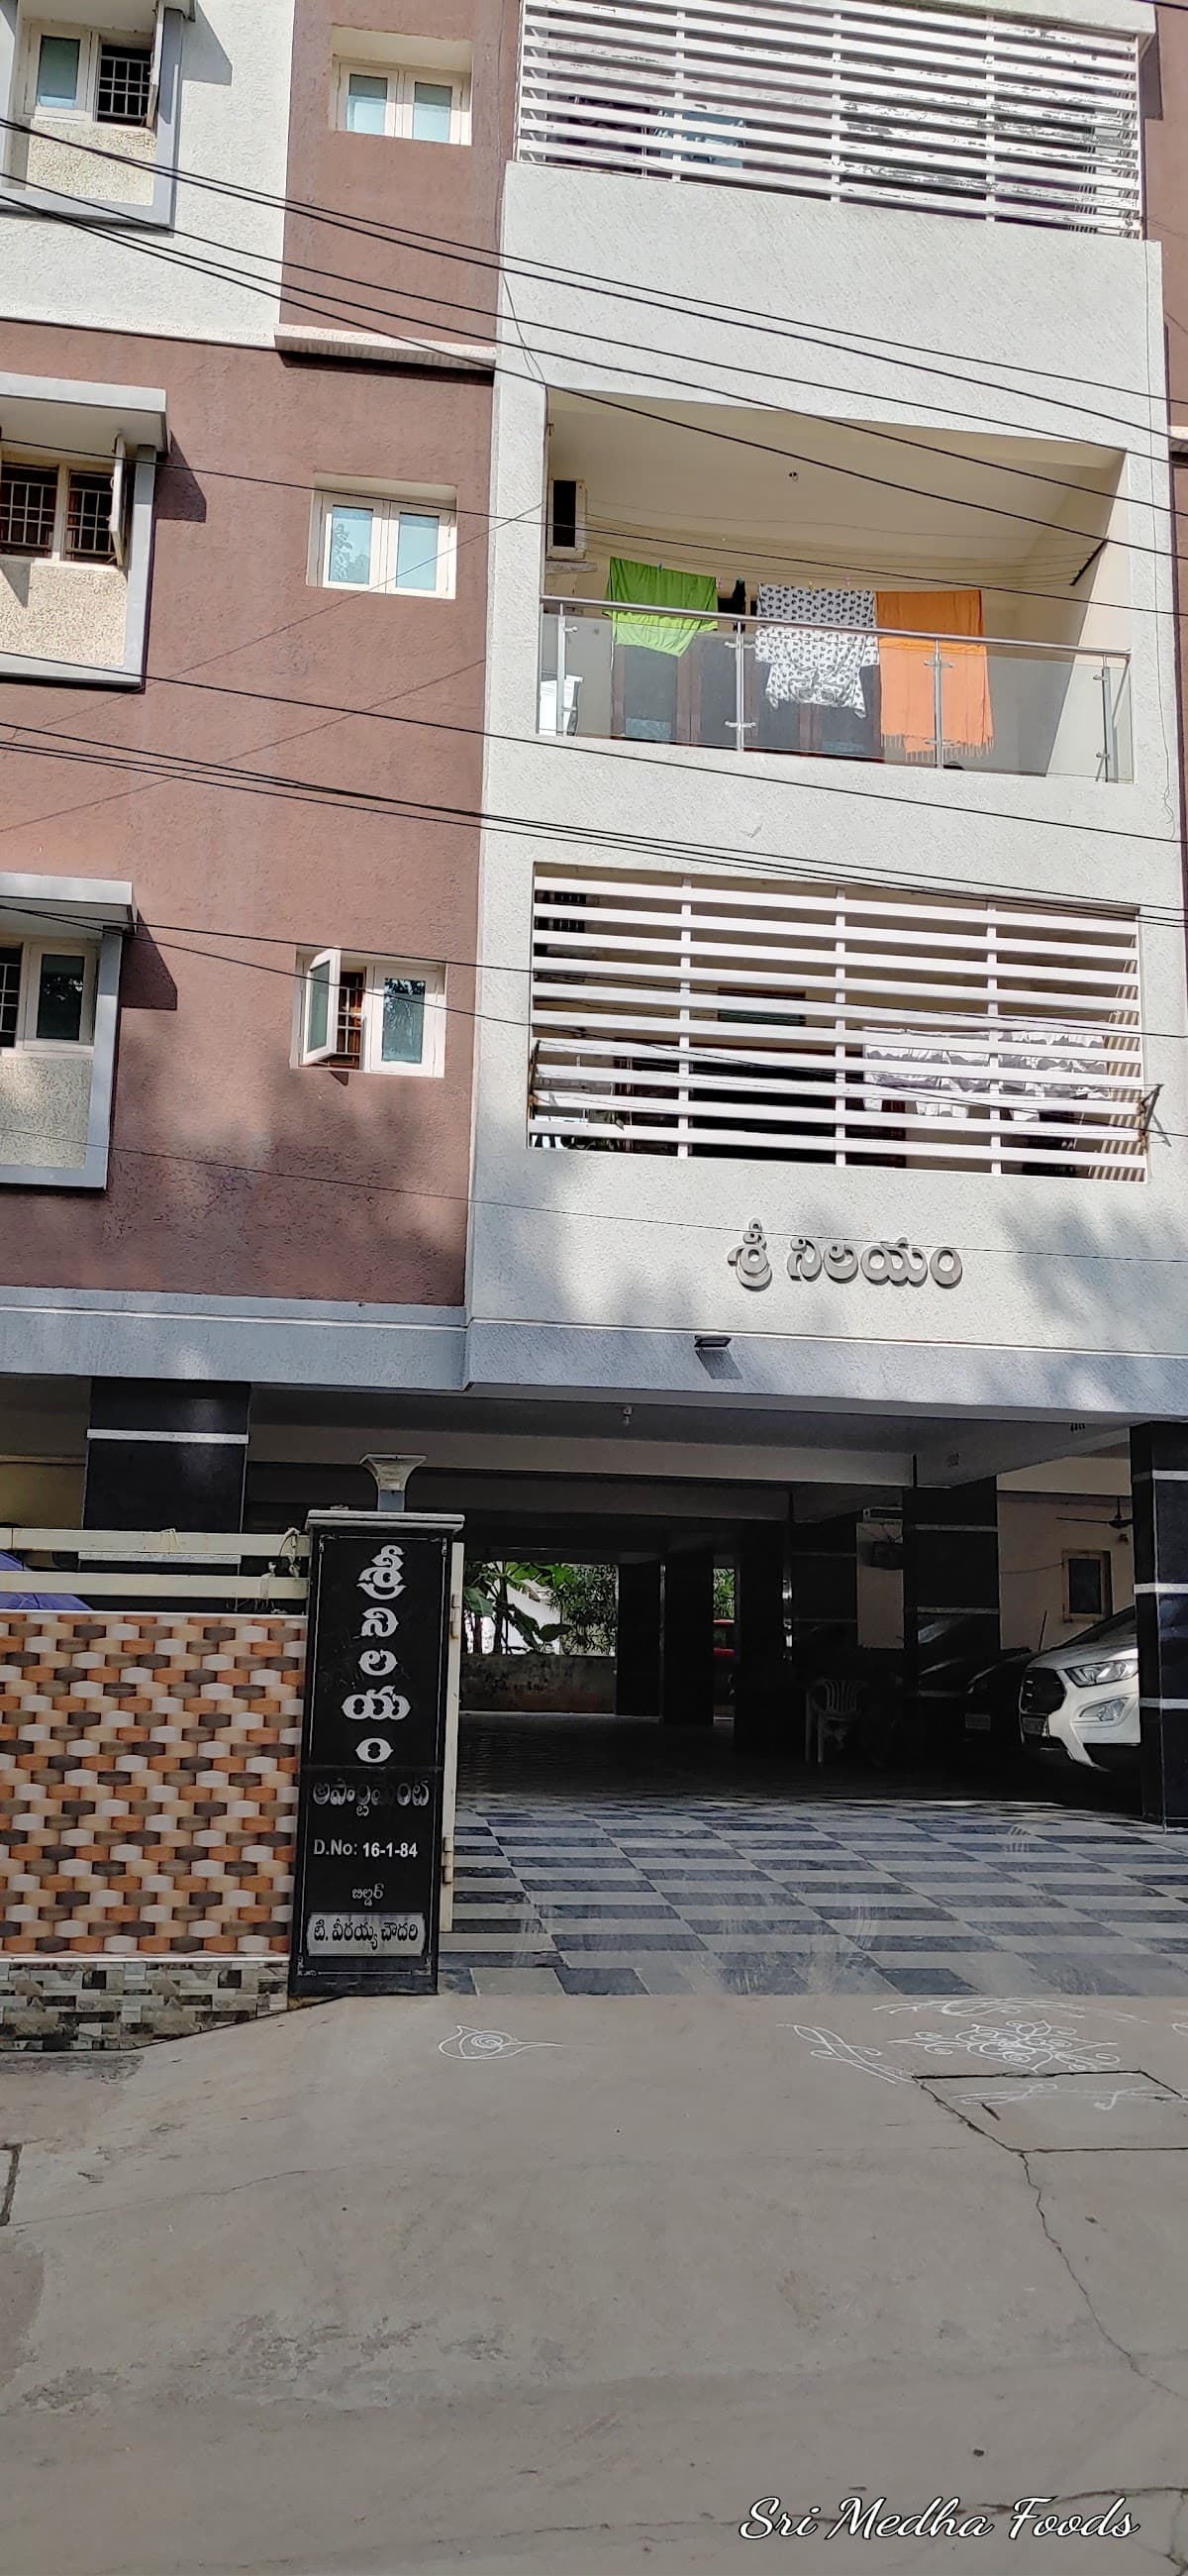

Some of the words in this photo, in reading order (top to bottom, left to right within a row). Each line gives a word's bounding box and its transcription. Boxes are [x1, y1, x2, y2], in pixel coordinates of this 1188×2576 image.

[727, 1217, 773, 1291] శ్రీ
[786, 1236, 963, 1289] నిలయం
[313, 1839, 358, 1856] D.No:
[362, 1841, 419, 1858] 16-1-84
[351, 1883, 385, 1906] బిల్డర్
[332, 1917, 378, 1950] వీరయ్య
[380, 1921, 419, 1941] చౌదరి
